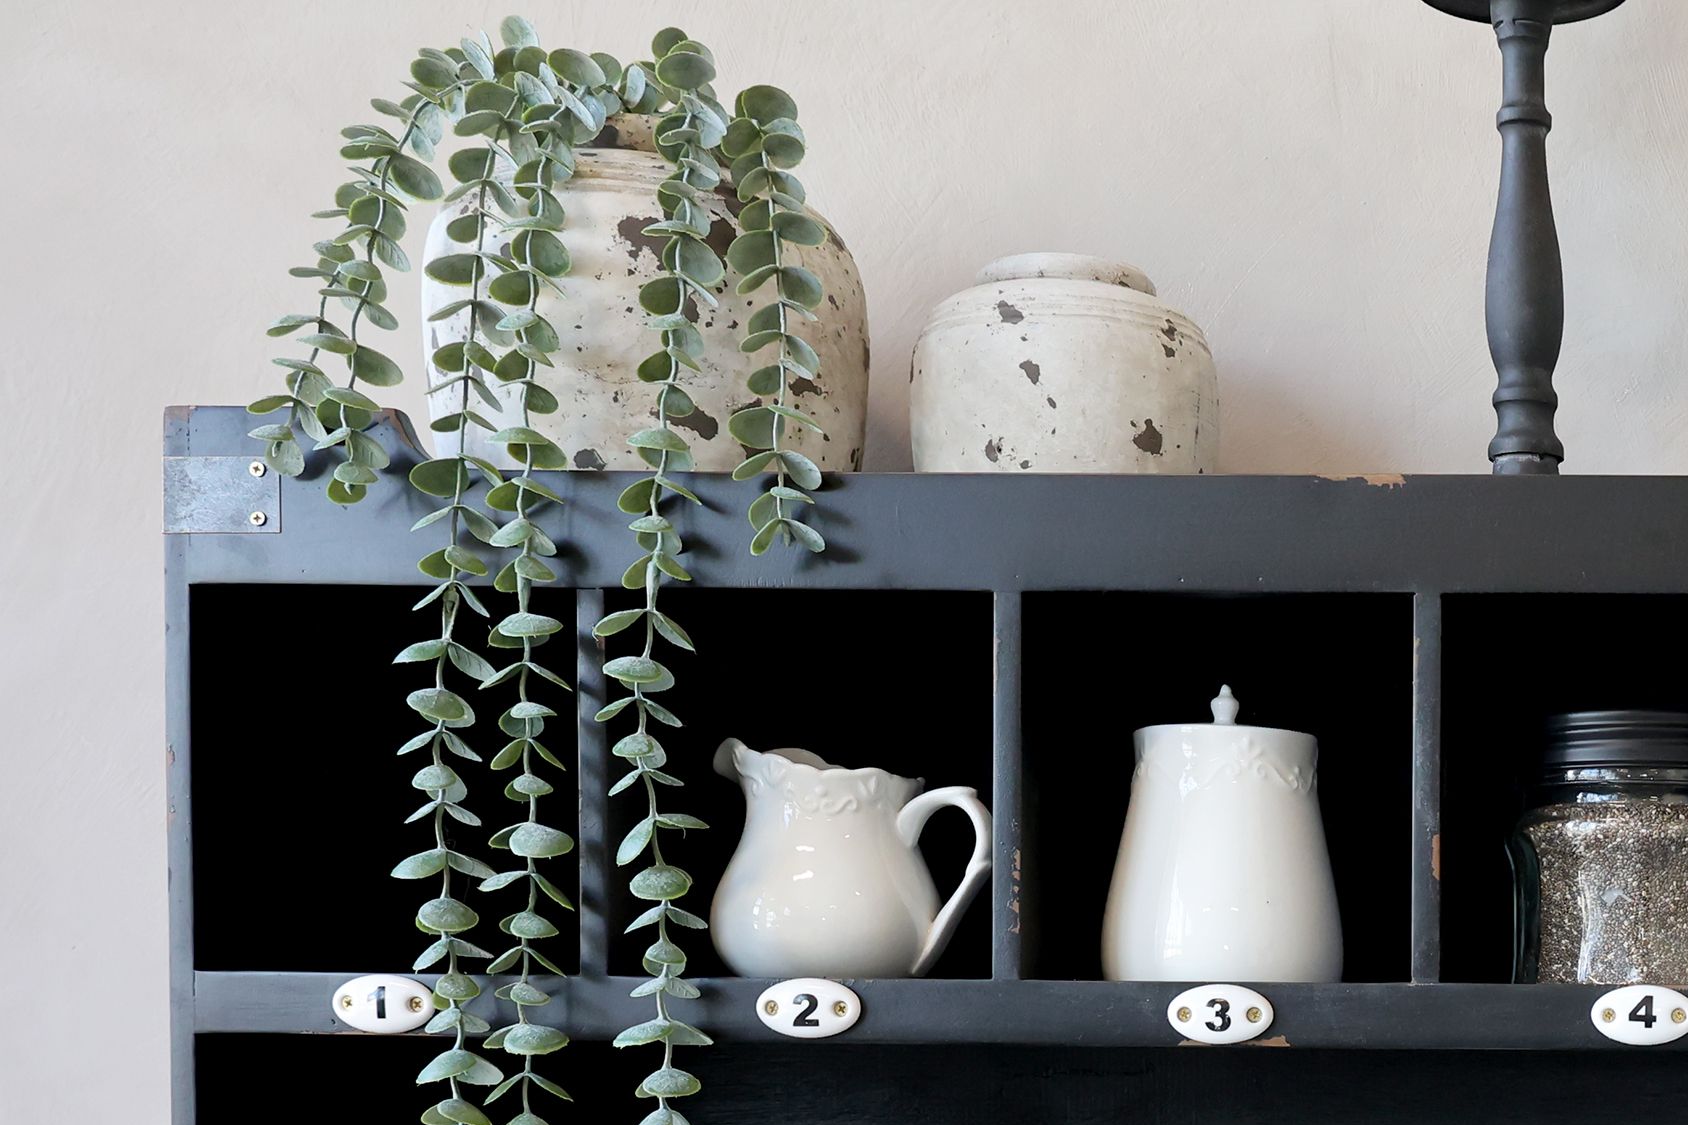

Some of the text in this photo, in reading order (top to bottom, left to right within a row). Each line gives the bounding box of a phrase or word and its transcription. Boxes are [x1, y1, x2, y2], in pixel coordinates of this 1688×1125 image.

[367, 986, 387, 1019] 1
[793, 994, 820, 1026] 2
[1205, 999, 1232, 1032] 3
[1629, 996, 1656, 1029] 4
